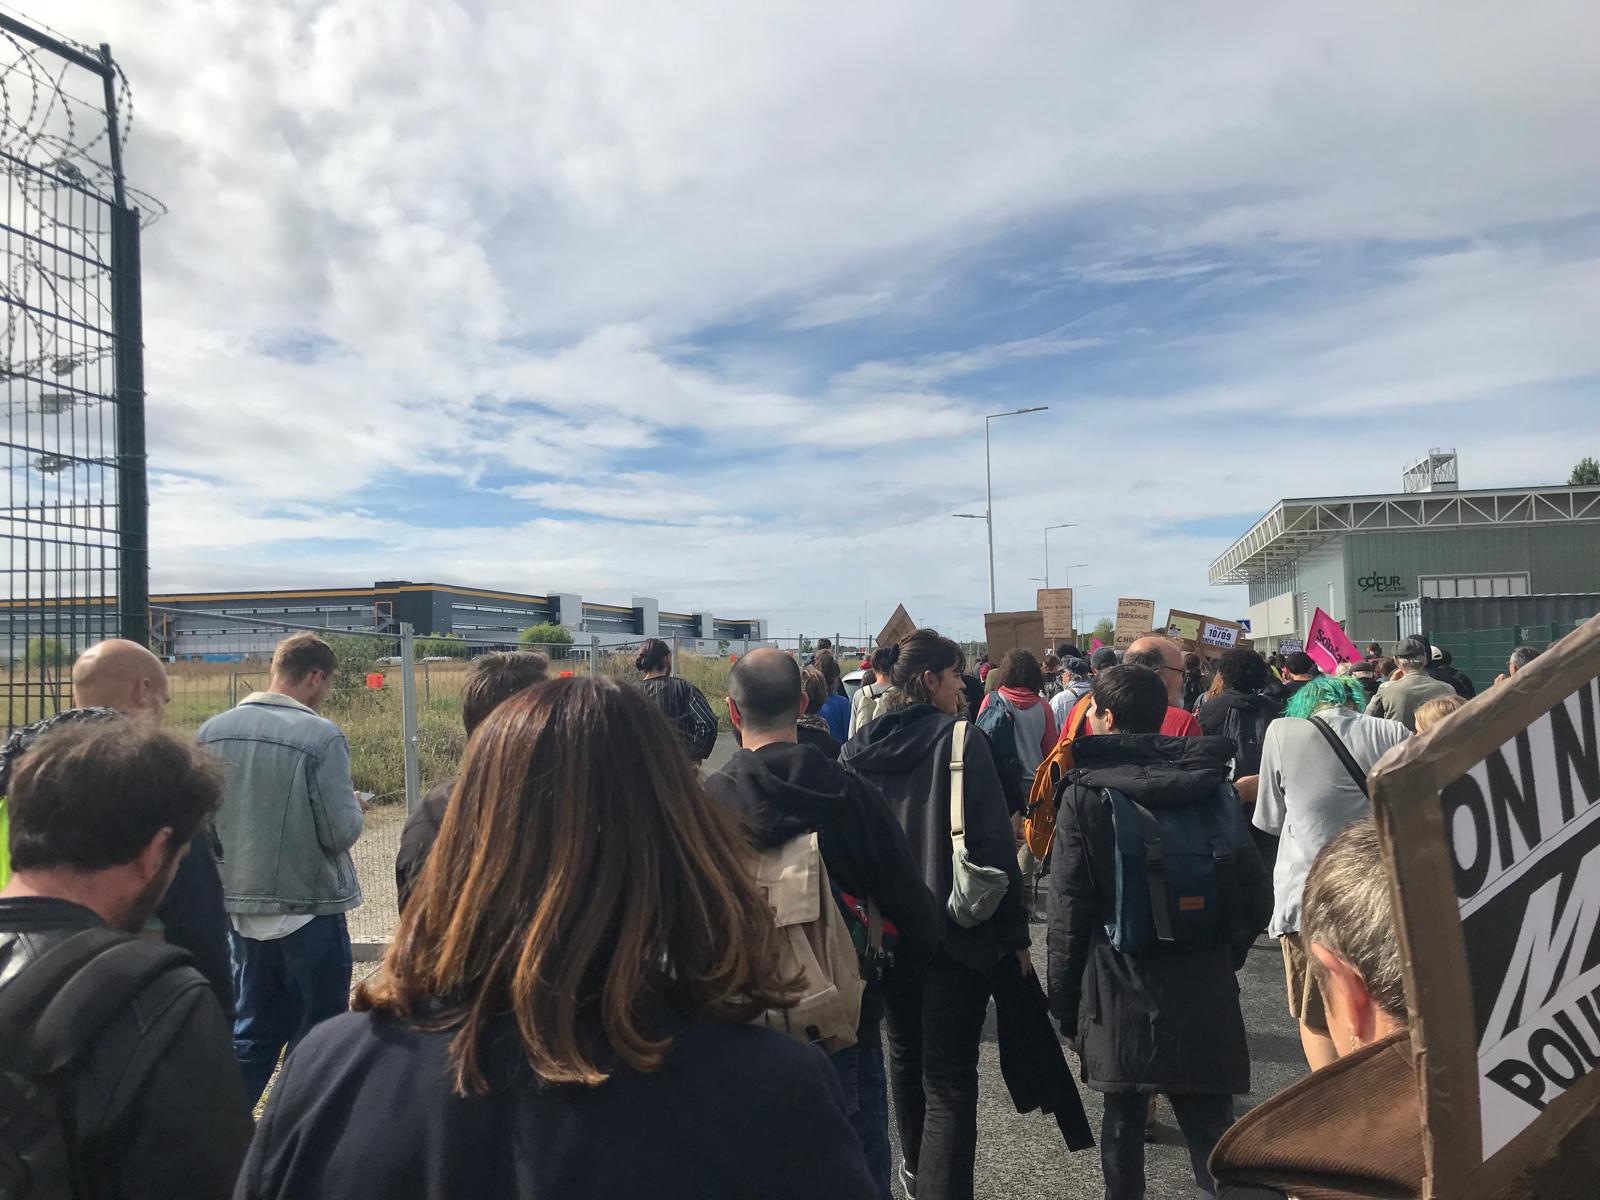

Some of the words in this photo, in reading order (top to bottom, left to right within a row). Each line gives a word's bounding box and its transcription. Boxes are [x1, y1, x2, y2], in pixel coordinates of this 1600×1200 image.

[1209, 629, 1232, 641] 10/09
[1440, 727, 1542, 899] ON
[1550, 675, 1600, 825] N
[1485, 983, 1600, 1112] POU
